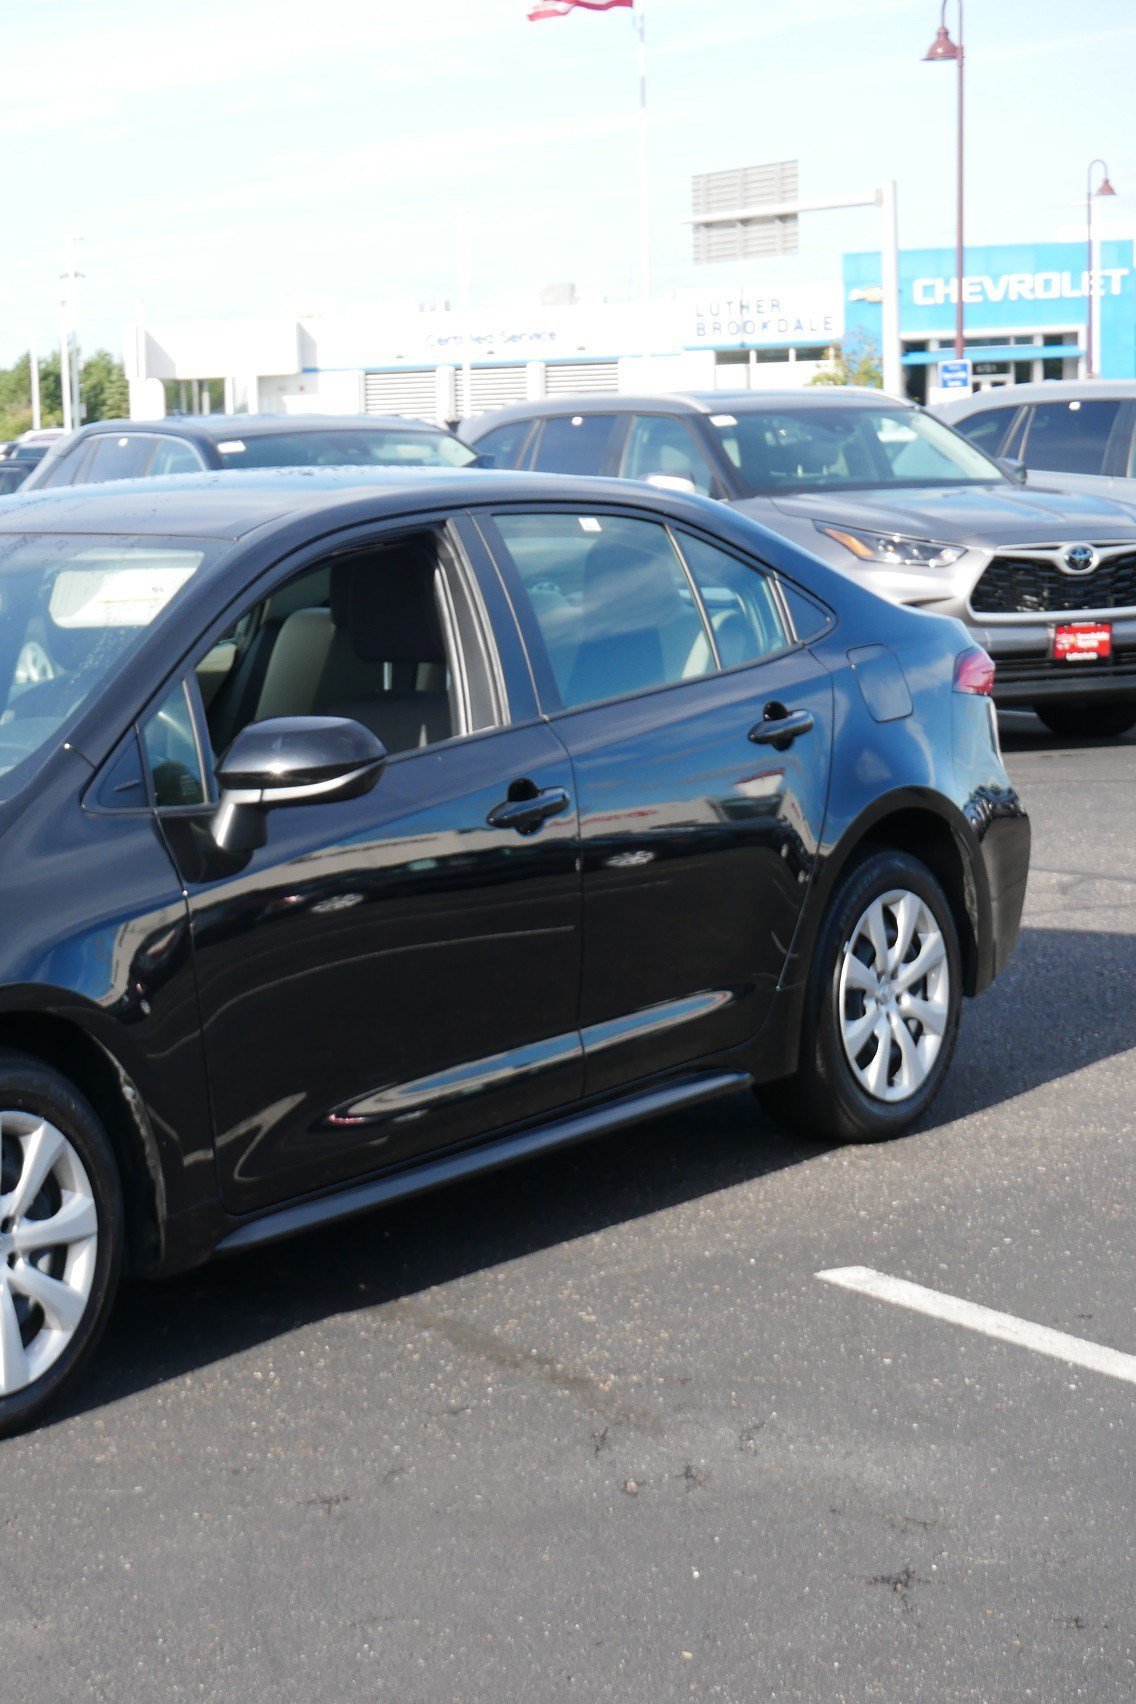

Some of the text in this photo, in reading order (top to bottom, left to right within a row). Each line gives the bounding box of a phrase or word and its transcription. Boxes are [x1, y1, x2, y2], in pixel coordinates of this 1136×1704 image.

[913, 268, 1130, 306] CHEVROLET
[696, 298, 781, 317] LUTHER
[696, 315, 833, 337] BROOKDALE
